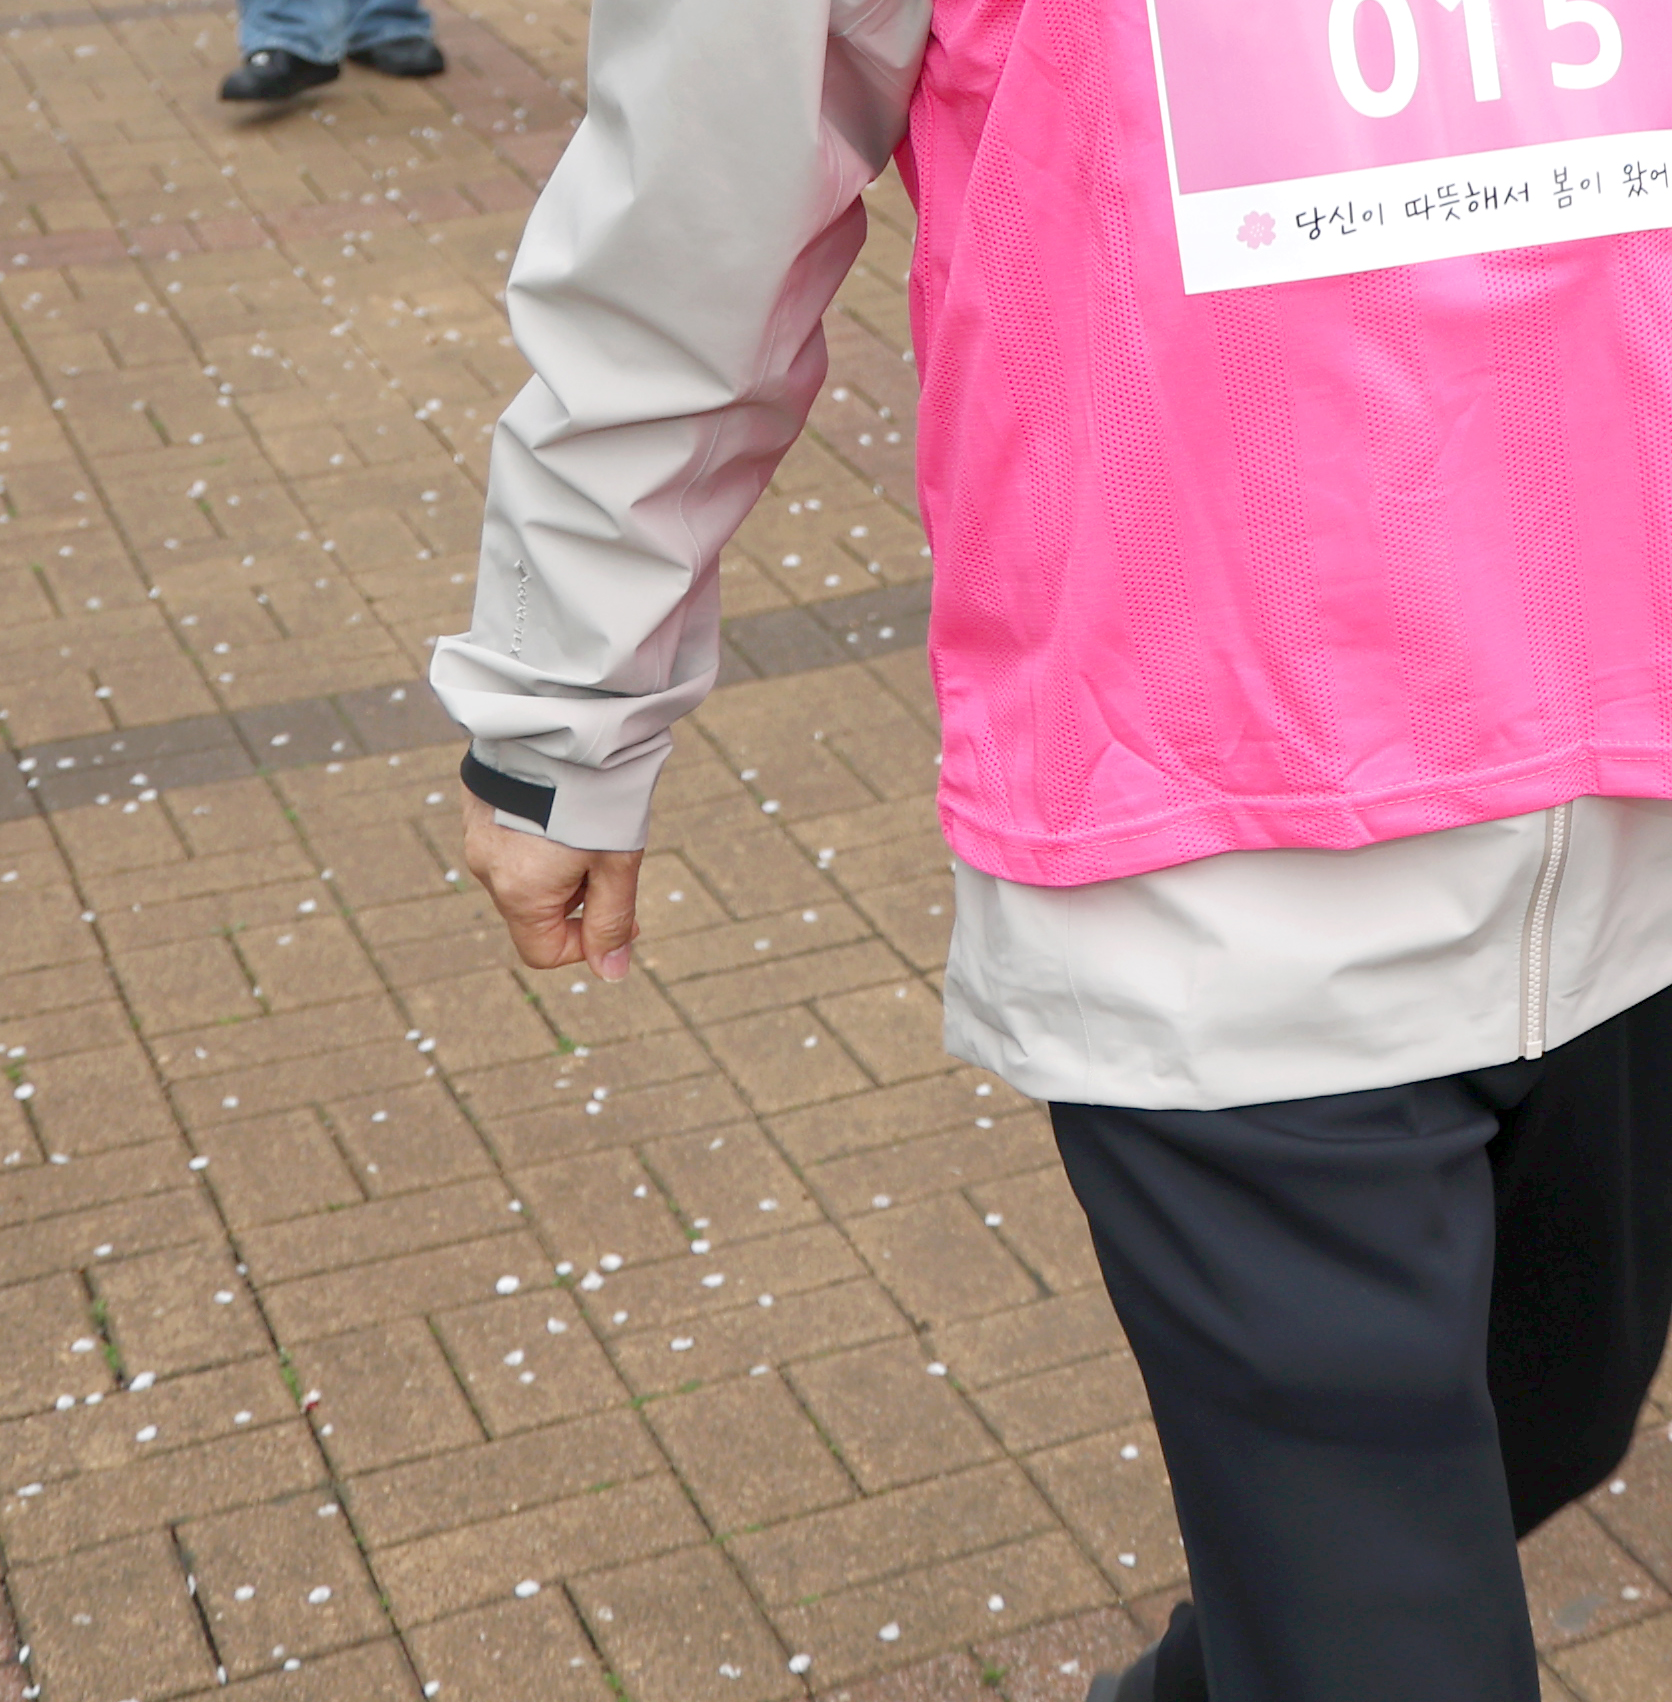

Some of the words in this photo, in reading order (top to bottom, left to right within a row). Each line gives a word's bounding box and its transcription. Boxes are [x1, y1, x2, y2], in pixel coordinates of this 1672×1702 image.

[1296, 206, 1384, 241] 당신이
[1405, 182, 1529, 221] 따뜻해서
[1552, 166, 1602, 208] 봄이
